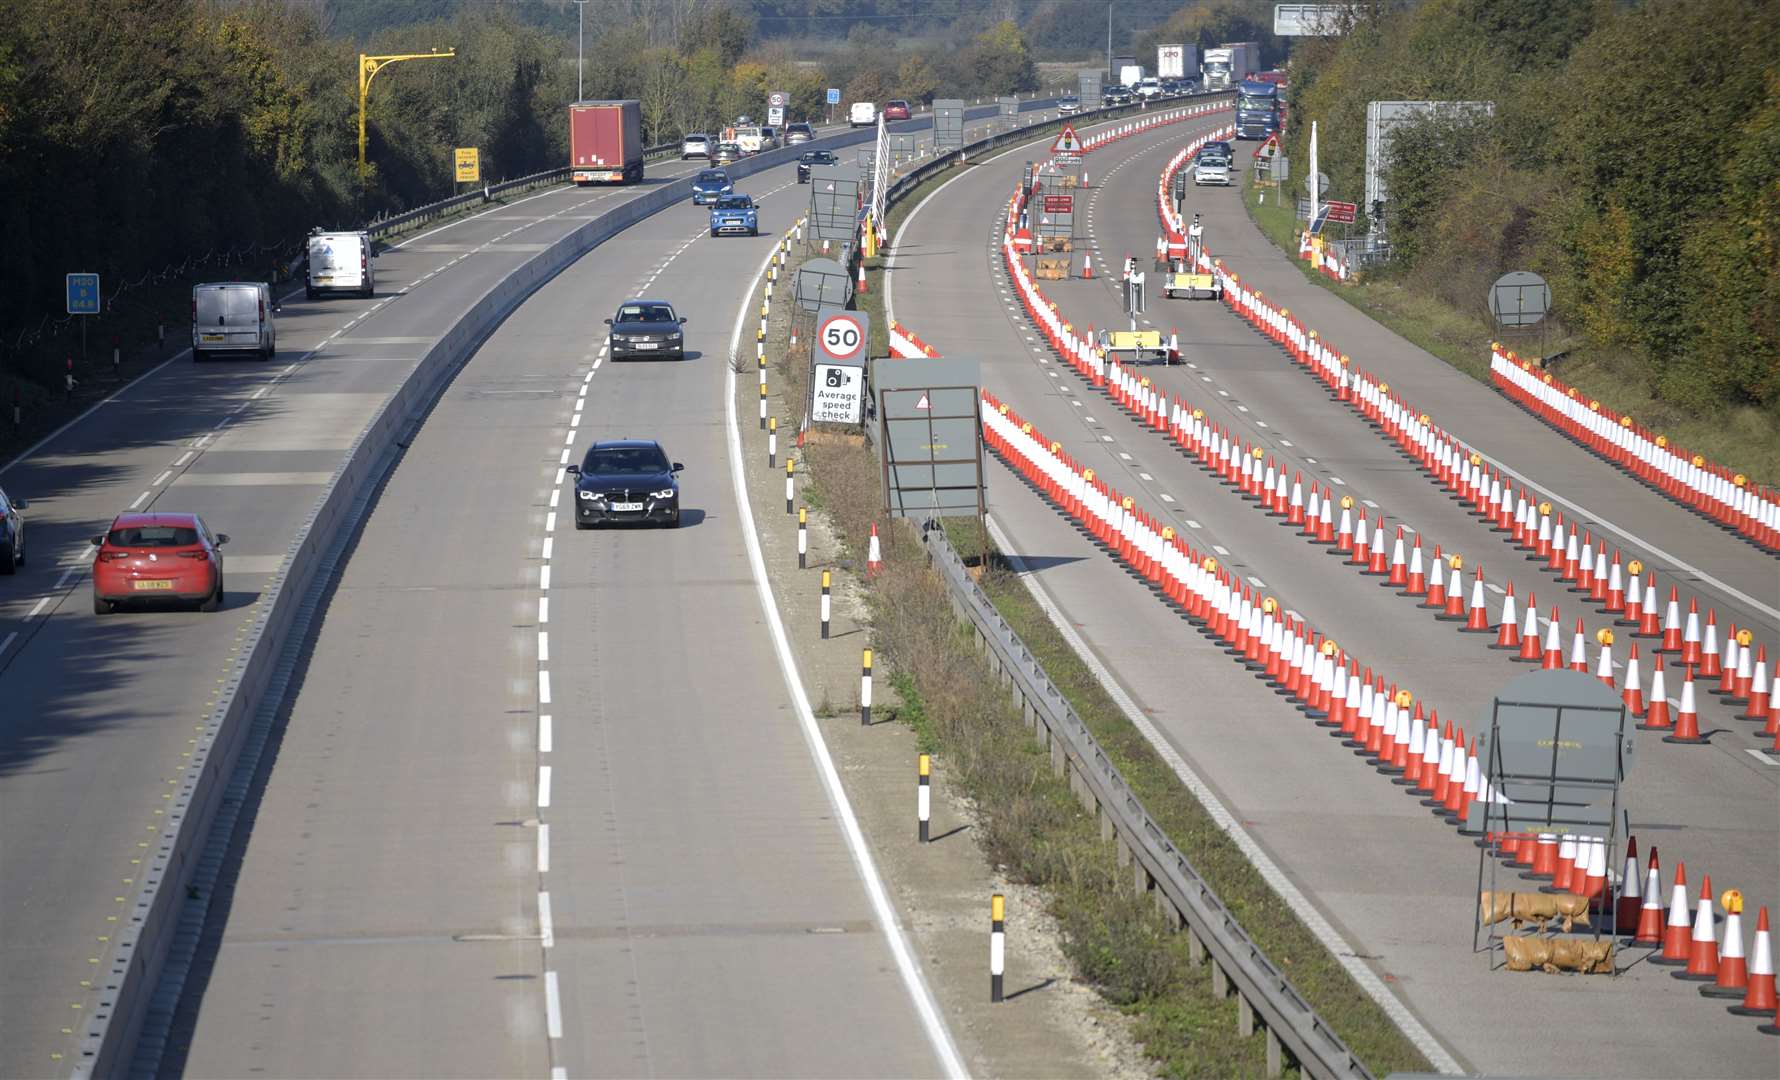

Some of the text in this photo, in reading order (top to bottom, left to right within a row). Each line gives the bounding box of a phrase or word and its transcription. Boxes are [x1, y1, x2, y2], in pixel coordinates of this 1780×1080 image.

[827, 328, 858, 347] 50
[817, 390, 857, 401] Average
[822, 400, 851, 410] speed
[821, 410, 850, 420] check
